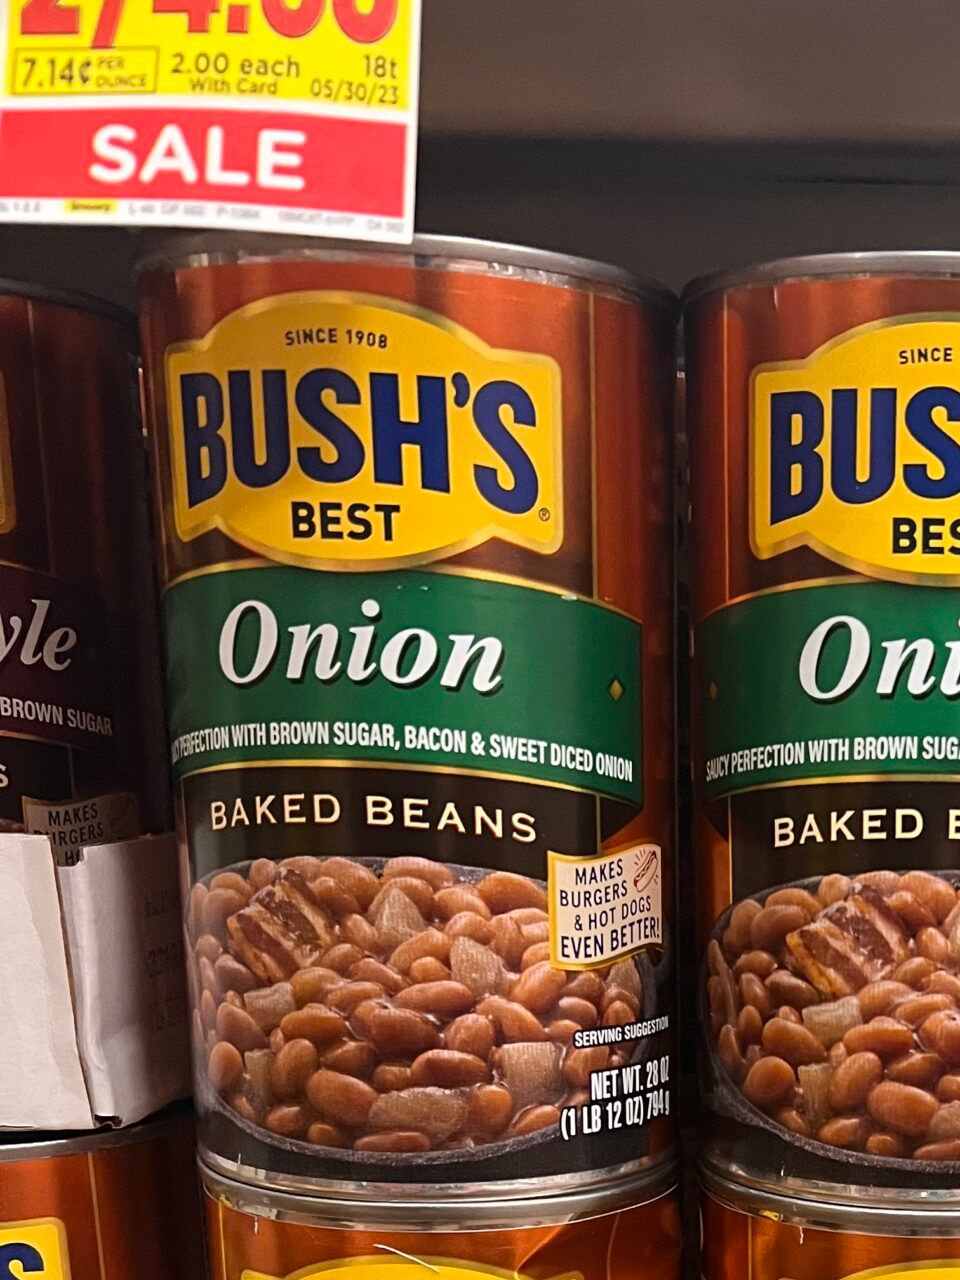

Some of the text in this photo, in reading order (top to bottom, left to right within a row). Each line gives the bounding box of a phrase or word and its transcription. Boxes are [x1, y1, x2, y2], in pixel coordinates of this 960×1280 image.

[22, 57, 91, 88] 7.14¢
[171, 53, 300, 78] 2.00 each
[365, 55, 398, 79] 18t
[190, 77, 278, 94] With Card
[310, 78, 399, 104] 05/30/23
[89, 124, 306, 190] SALE
[285, 327, 388, 349] SINCE 1908
[899, 348, 952, 365] SINCE
[179, 367, 540, 516] BUSH'S
[291, 501, 401, 542] BEST
[219, 599, 503, 693] Onion
[1, 697, 112, 736] BROWN SUGAR
[180, 726, 229, 757] PERFECTION
[231, 723, 266, 747] WITH
[270, 721, 329, 744] BROWN
[333, 722, 401, 751] SUGAR,
[404, 725, 467, 755] BACON
[471, 731, 485, 756] &
[489, 734, 546, 766] SWEET
[549, 744, 593, 773] DICED
[595, 751, 633, 783] ONION
[49, 803, 98, 827] MAKES
[211, 792, 537, 843] BAKED BEANS
[774, 808, 923, 848] BAKED
